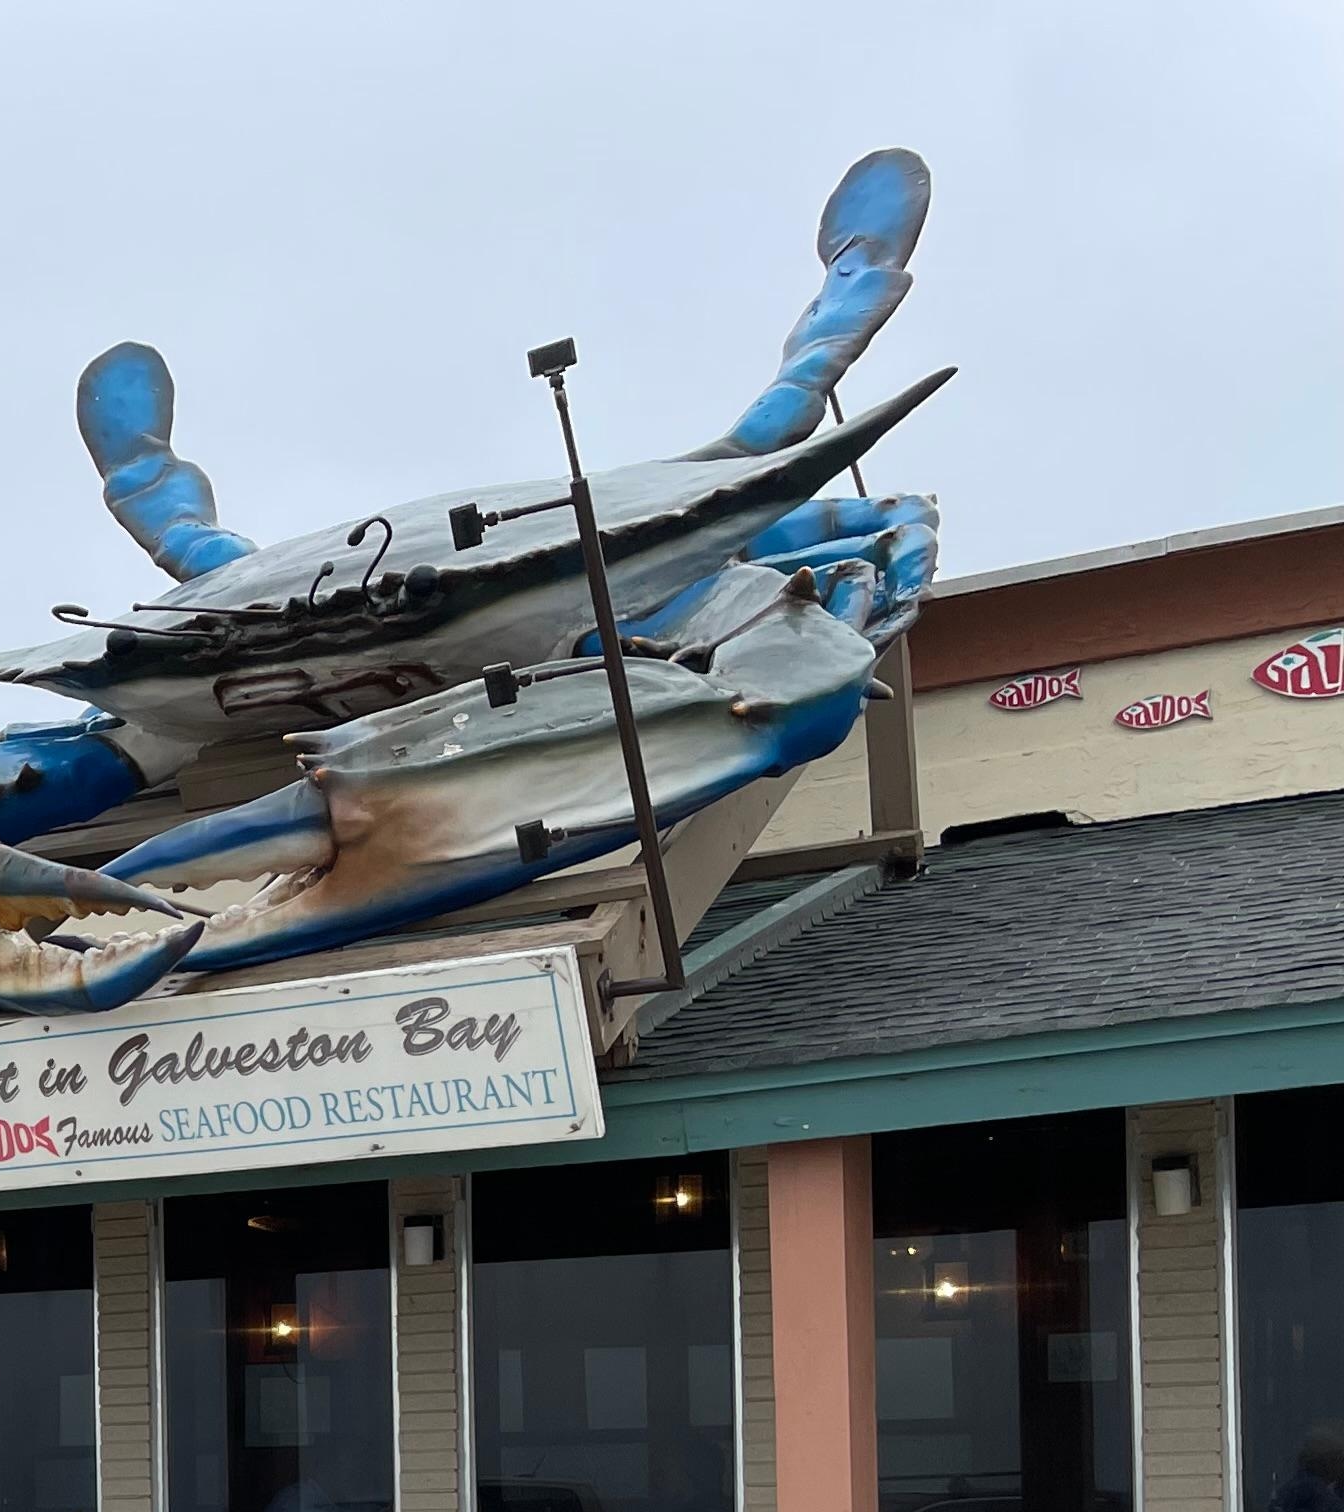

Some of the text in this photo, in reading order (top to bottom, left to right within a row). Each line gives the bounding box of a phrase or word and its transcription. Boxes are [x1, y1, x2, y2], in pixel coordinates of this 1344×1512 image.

[38, 1058, 88, 1097] in
[108, 1026, 373, 1107] Galveston
[395, 997, 522, 1061] Bay
[56, 1116, 153, 1156] Famous
[159, 1096, 311, 1143] SEAFOOD
[321, 1068, 558, 1126] RESTAURANT
